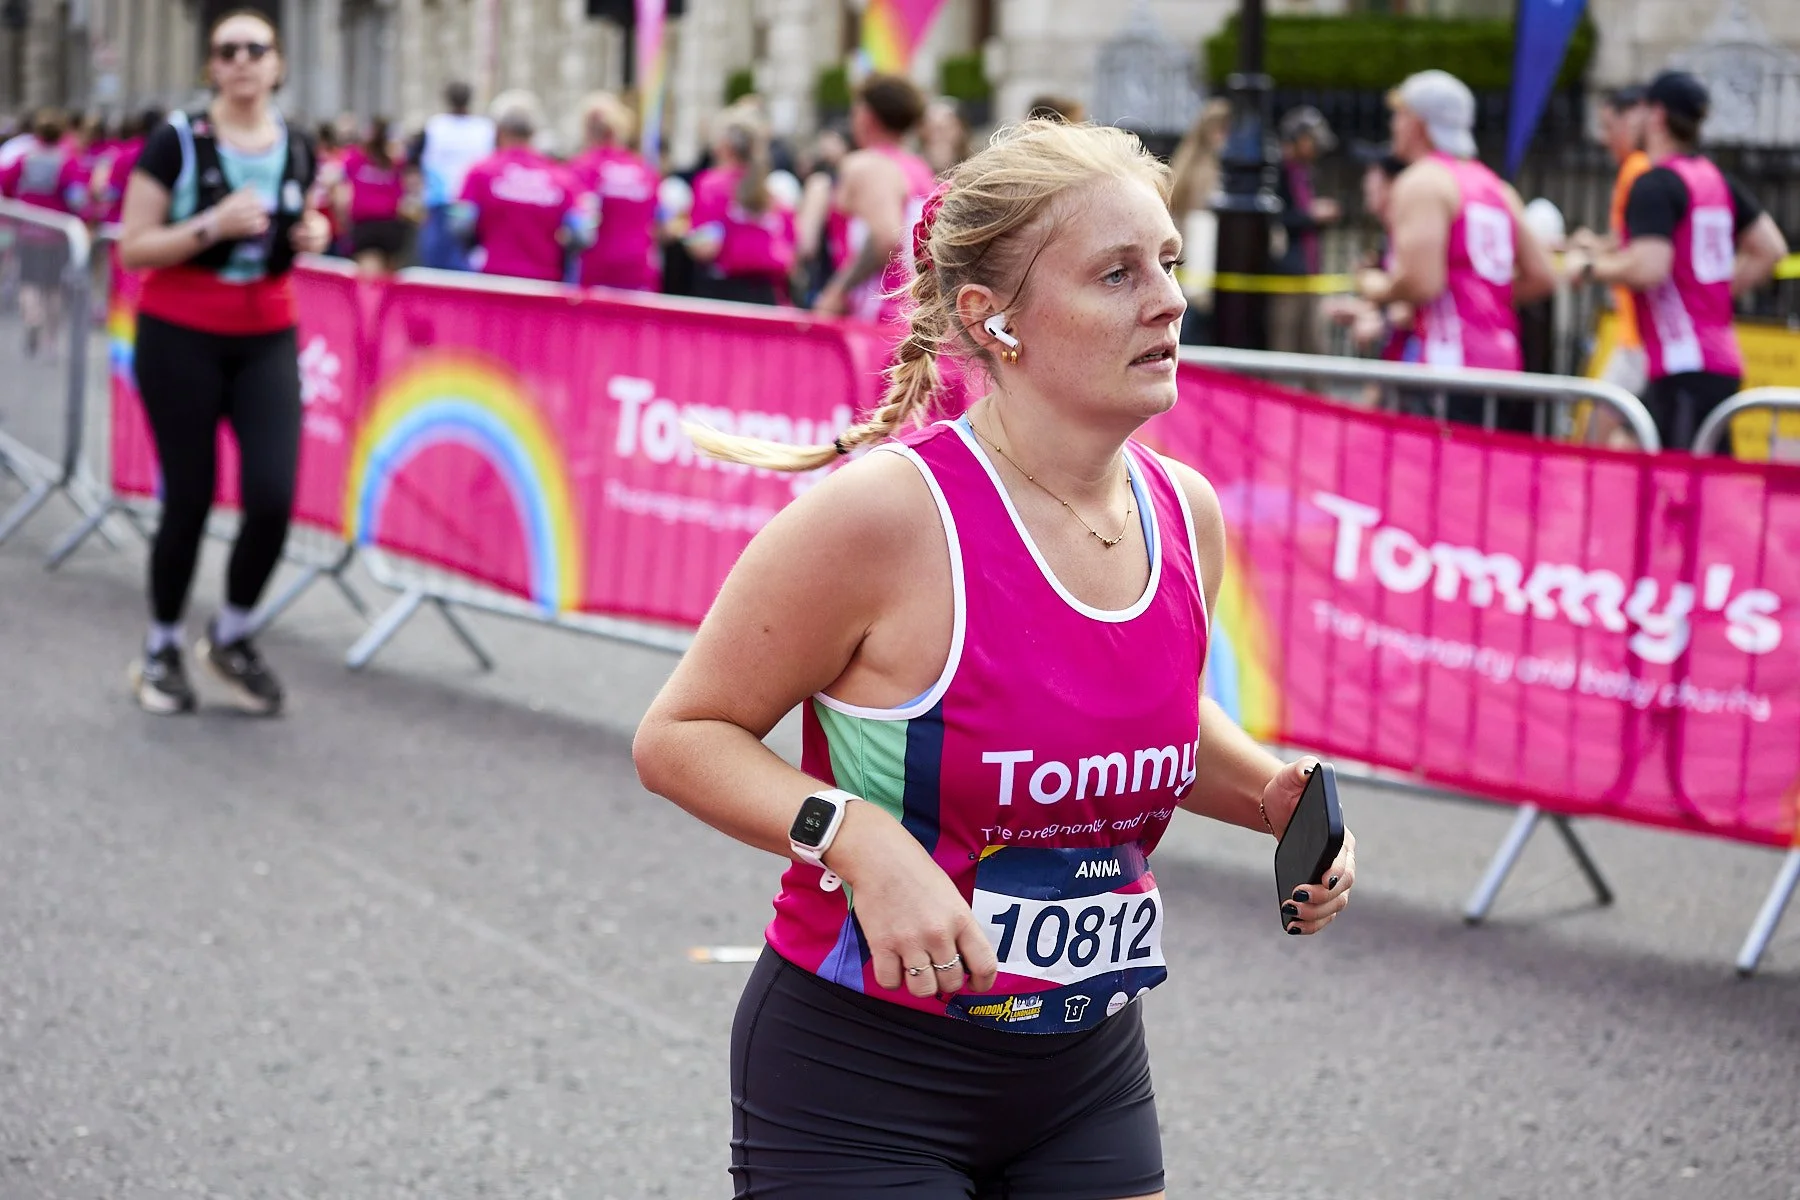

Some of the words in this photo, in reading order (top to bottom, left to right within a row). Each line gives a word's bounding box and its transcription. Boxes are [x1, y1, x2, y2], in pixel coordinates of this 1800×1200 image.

[1312, 490, 1782, 664] Tommy's
[1112, 812, 1142, 830] and
[1074, 858, 1121, 878] ANNA
[990, 897, 1157, 968] 10812
[967, 1003, 1004, 1015] LONDON
